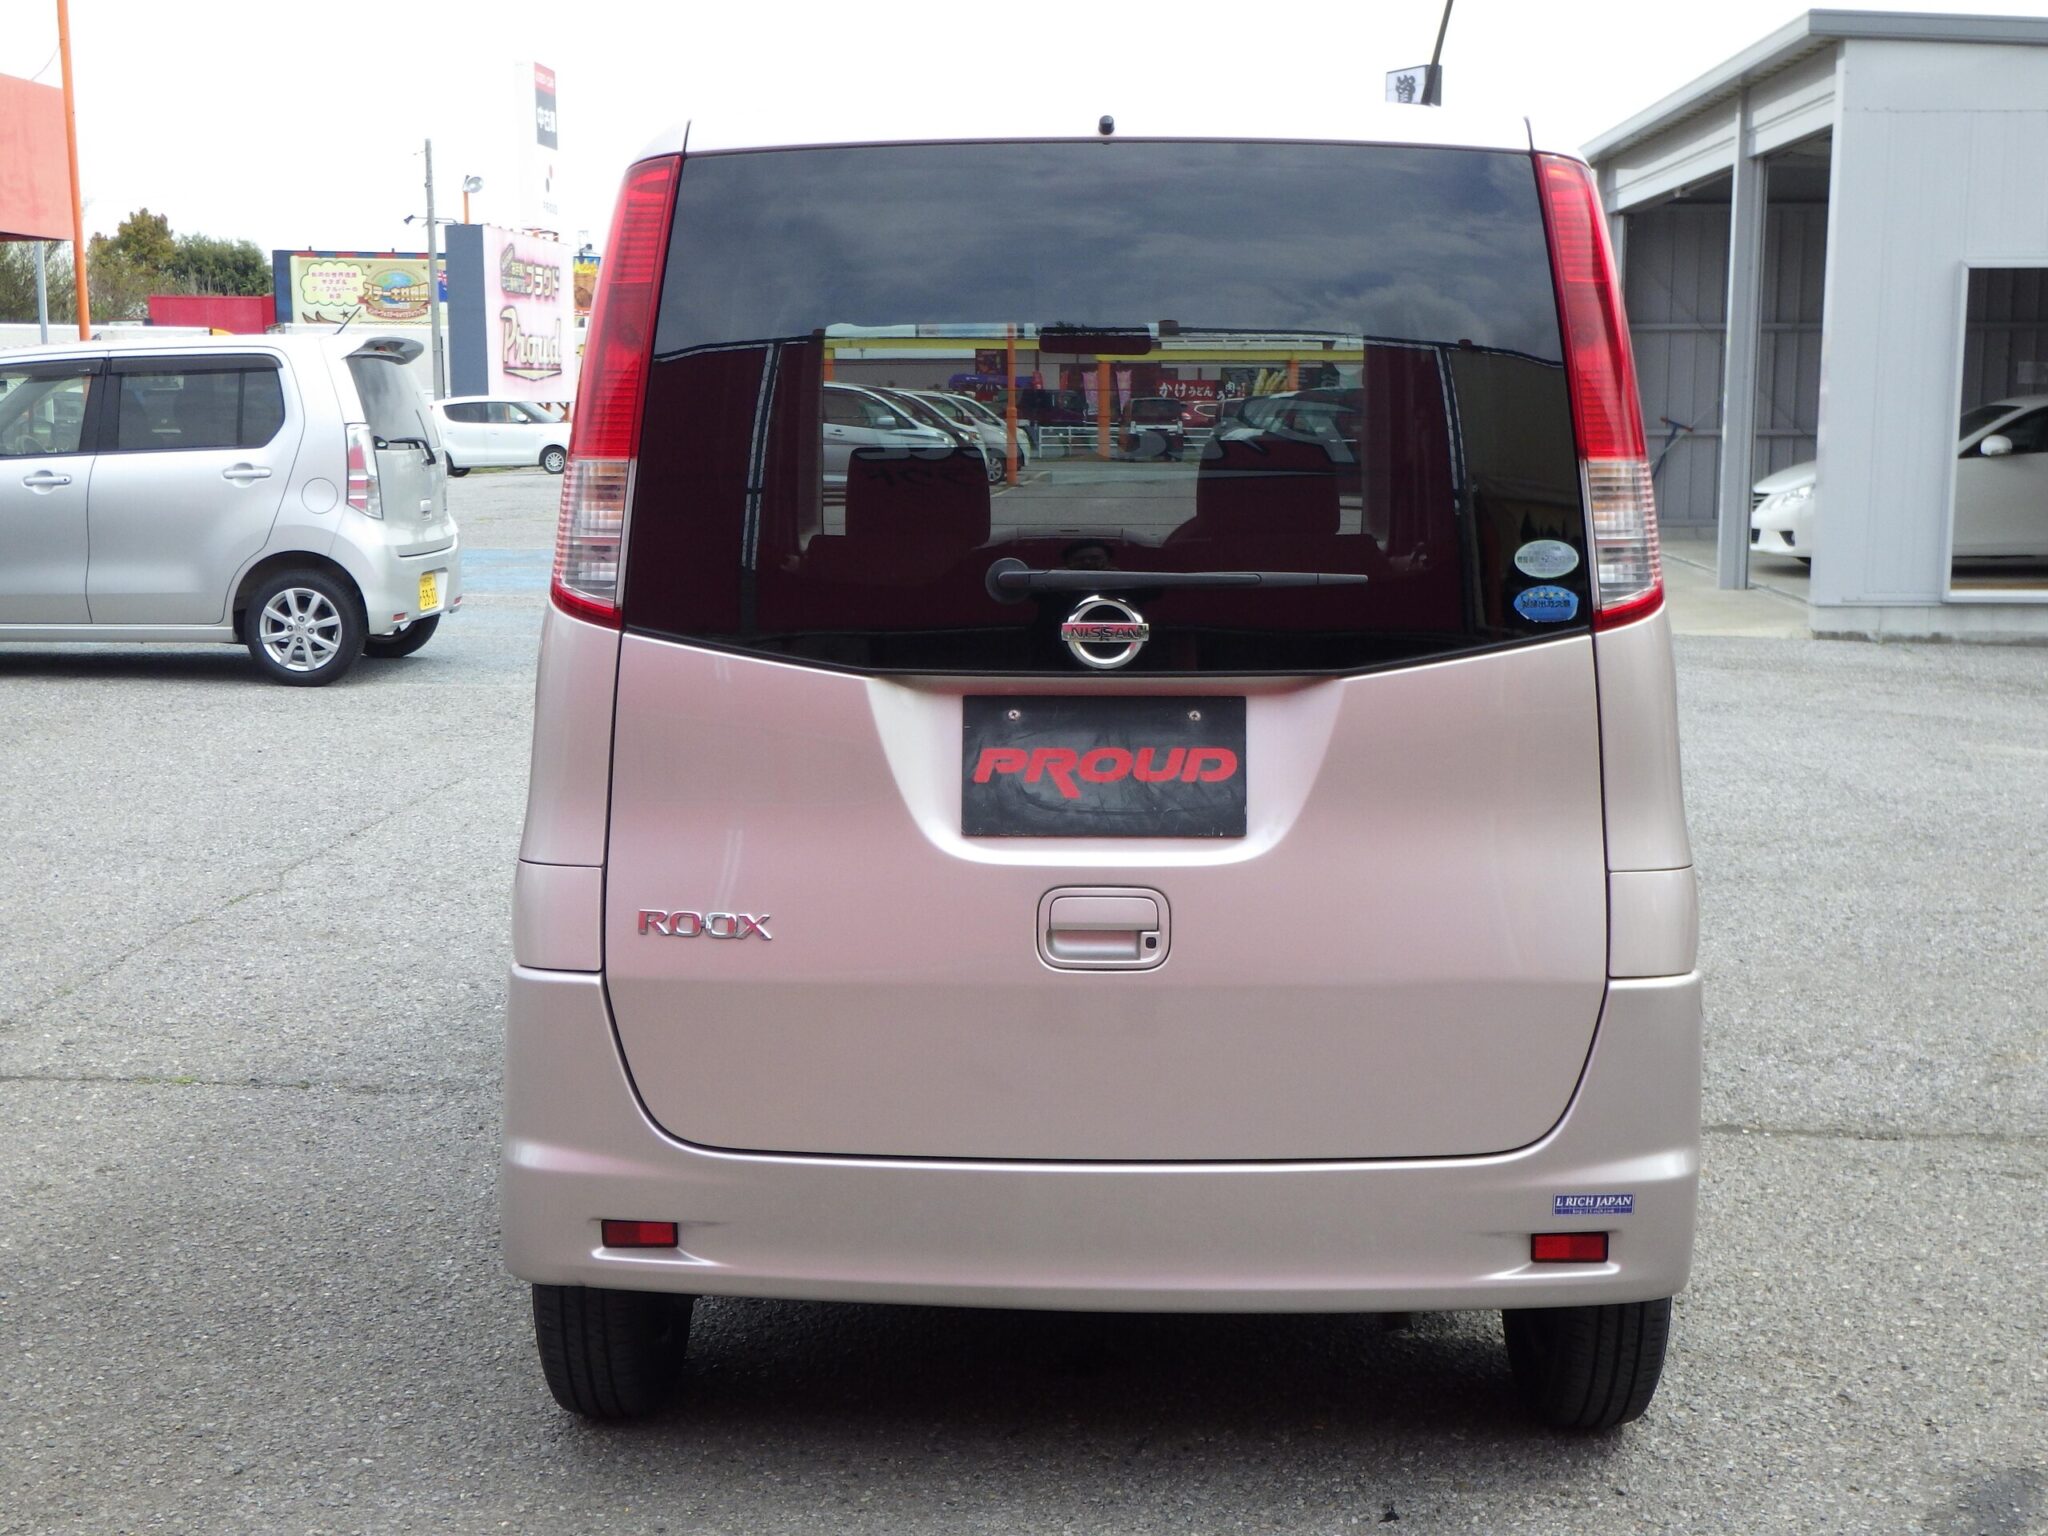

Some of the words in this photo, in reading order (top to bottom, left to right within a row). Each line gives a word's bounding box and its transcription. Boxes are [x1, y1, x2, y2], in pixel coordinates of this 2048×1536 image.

[500, 305, 561, 365] Proud
[1159, 381, 1214, 399] かけうどん
[1071, 626, 1140, 639] NISSAN
[972, 746, 1239, 800] PROUD
[1566, 1197, 1594, 1207] RICH
[1595, 1196, 1633, 1208] JAPAN
